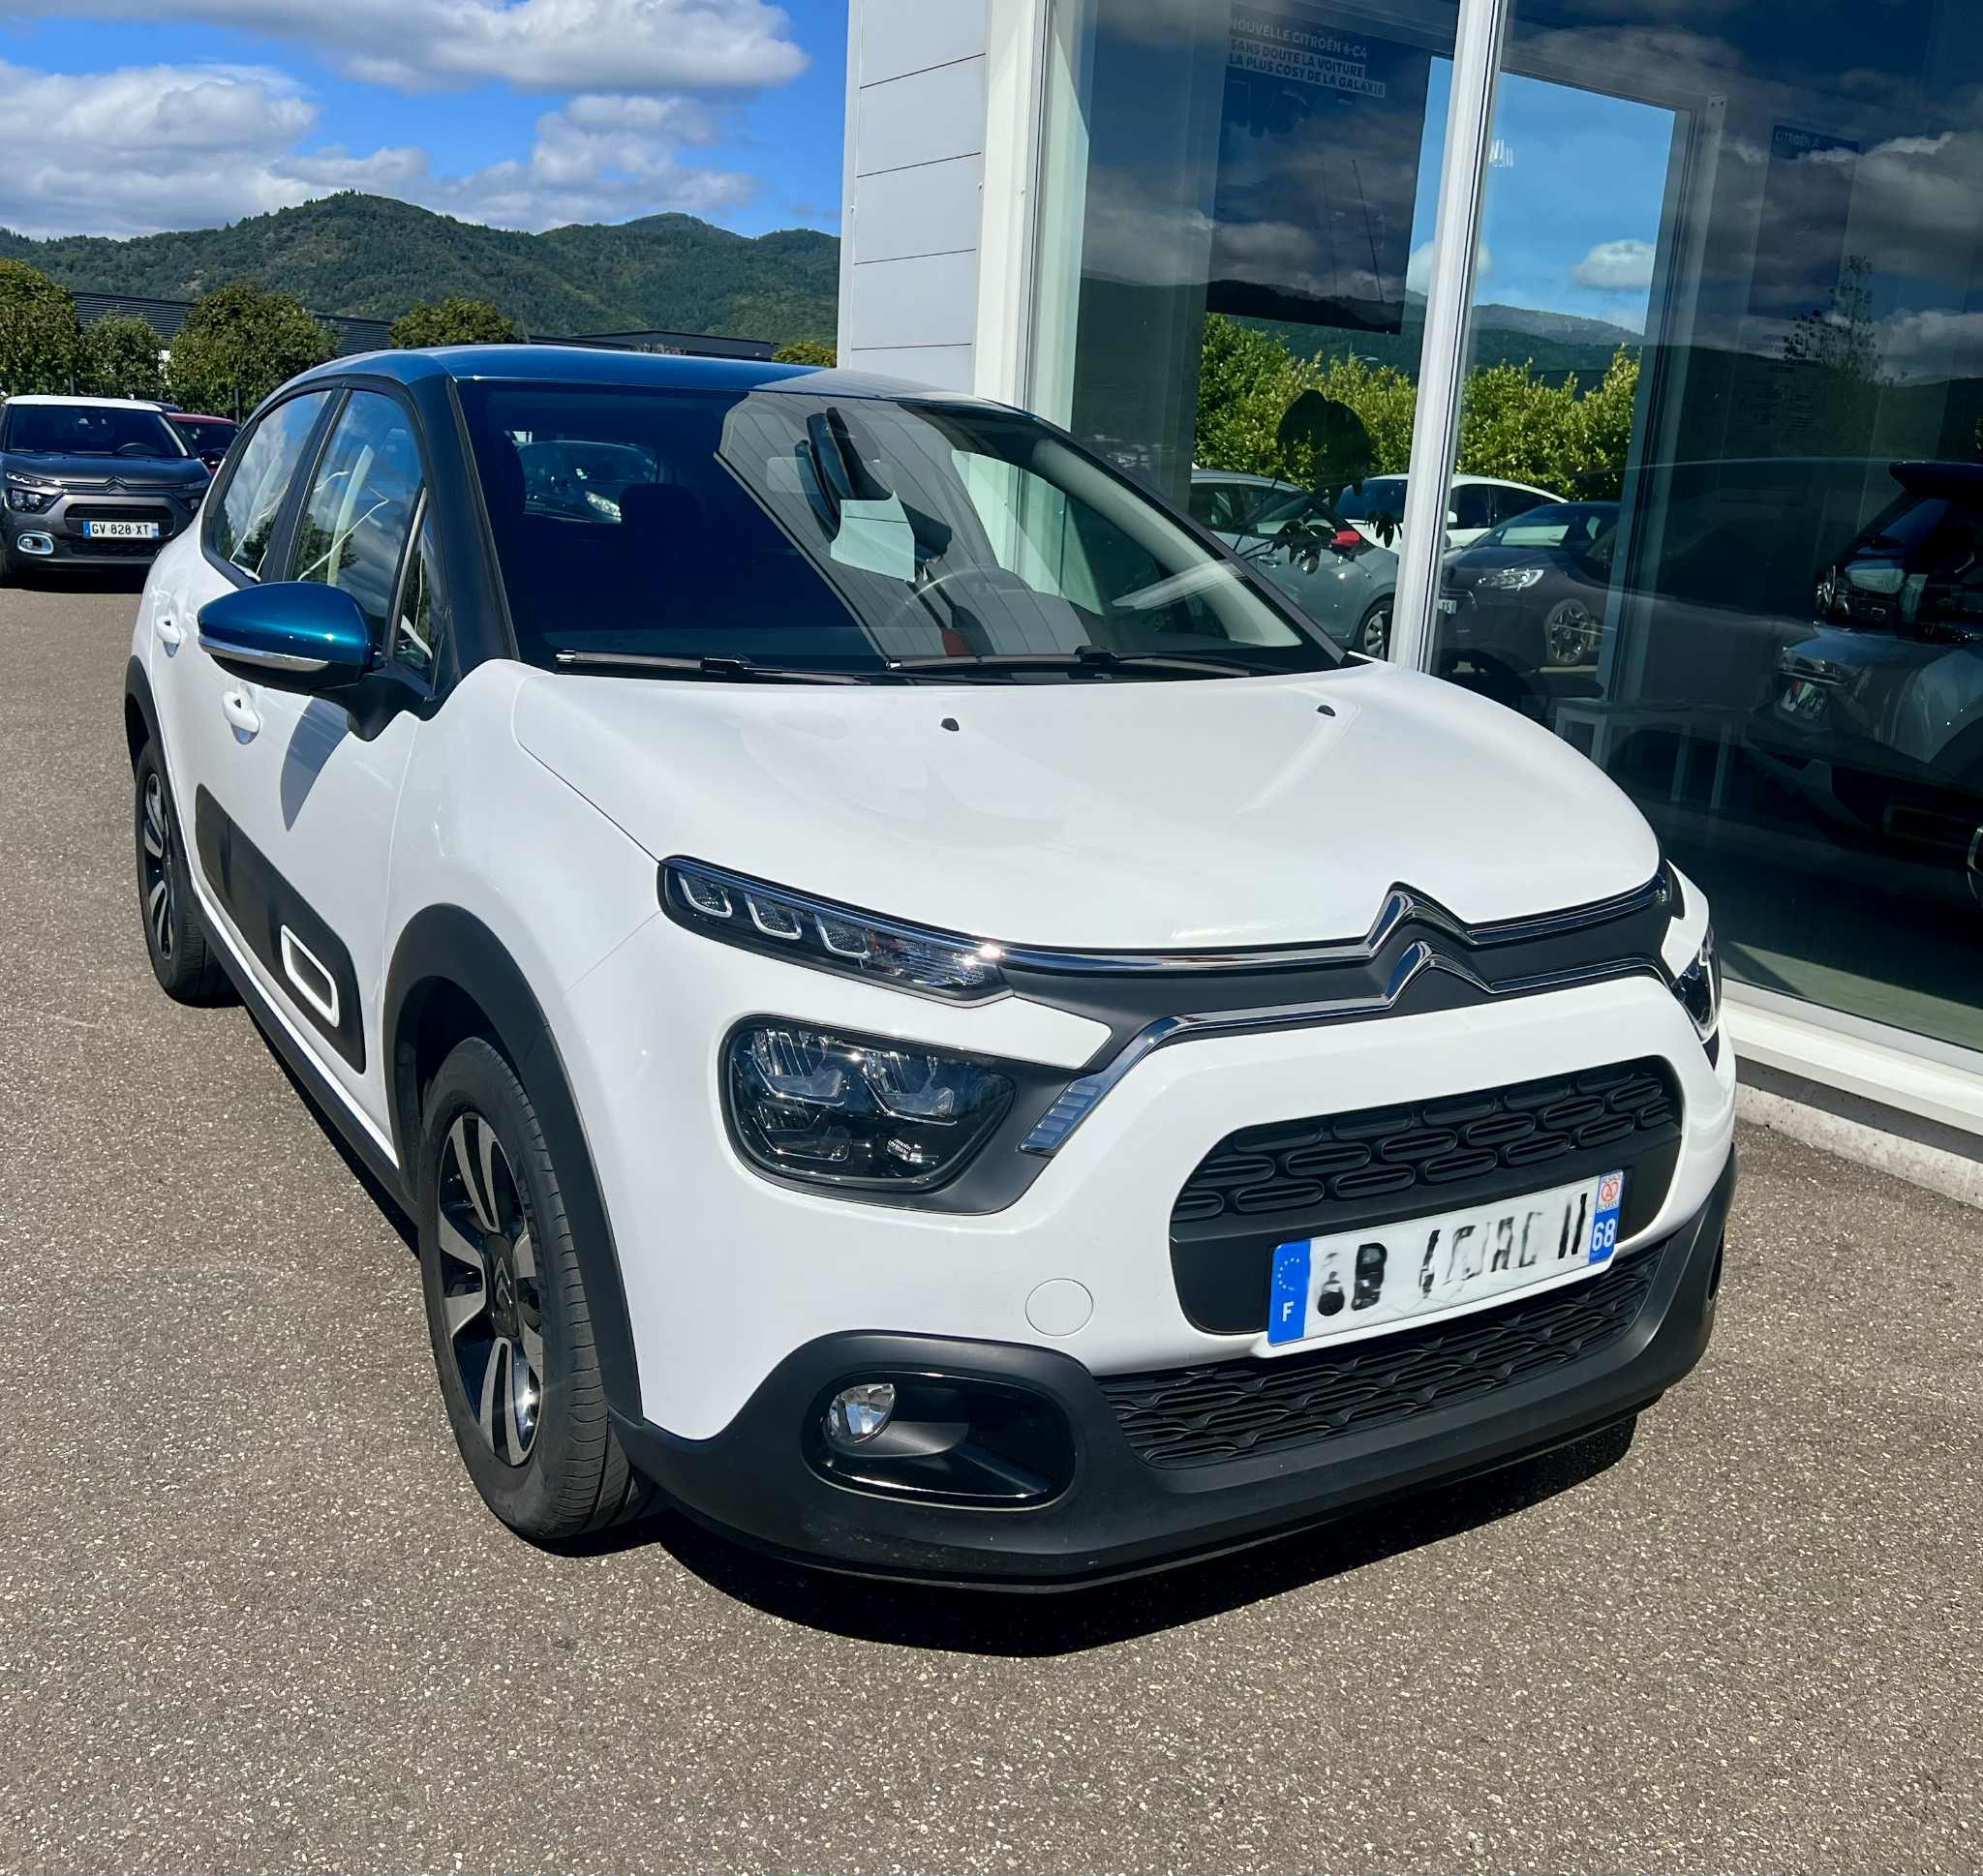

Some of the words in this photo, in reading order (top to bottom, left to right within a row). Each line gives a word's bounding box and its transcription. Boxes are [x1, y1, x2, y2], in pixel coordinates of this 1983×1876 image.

[1231, 39, 1259, 54] SANS
[1263, 45, 1299, 63] DOUTE
[1302, 54, 1315, 67] LA
[1318, 58, 1363, 76] VOITURE
[1247, 56, 1273, 73] PLUS
[1275, 63, 1305, 80] COSY
[1308, 70, 1321, 81] DE
[1323, 74, 1336, 86] LA
[92, 524, 106, 534] GV
[110, 524, 132, 535] 828
[136, 525, 149, 535] XT
[1592, 1218, 1616, 1252] 68
[1282, 1301, 1295, 1322] F
